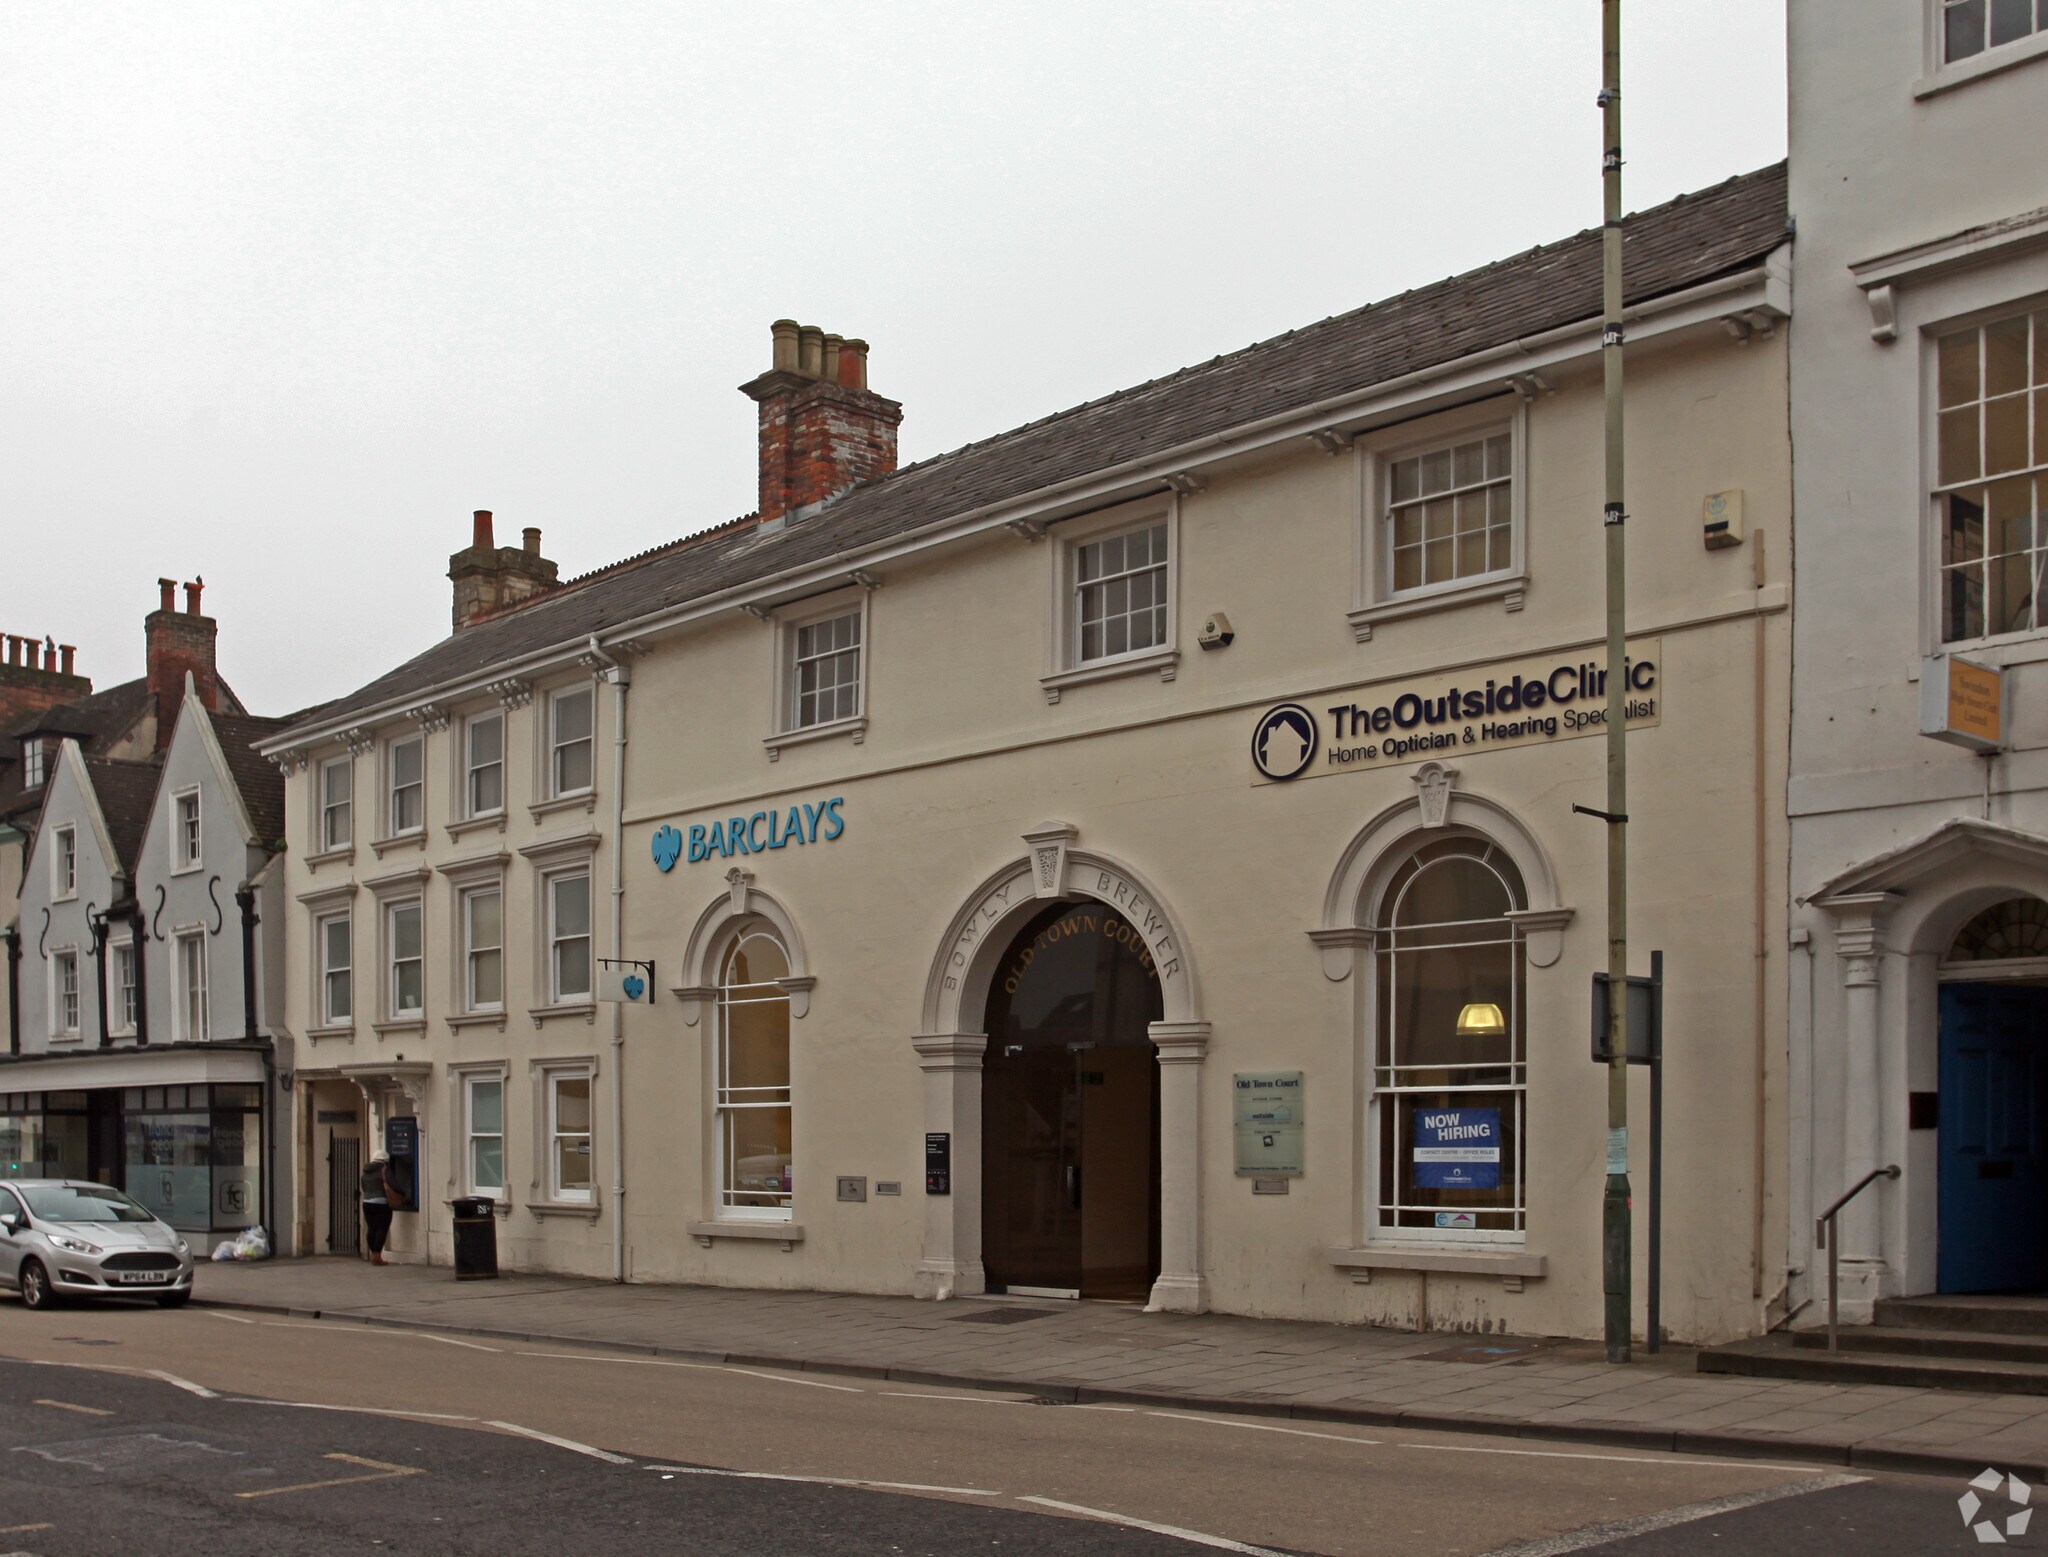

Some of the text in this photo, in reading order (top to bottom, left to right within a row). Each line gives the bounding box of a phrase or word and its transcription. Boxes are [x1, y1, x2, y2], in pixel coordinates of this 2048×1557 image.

[1328, 745, 1377, 764] Home
[1382, 731, 1457, 758] Optician
[1462, 725, 1475, 744] &
[1481, 716, 1557, 741] Hearing
[687, 796, 845, 863] BARCLAYS
[943, 871, 1181, 992] BOWLY BREWER
[1004, 947, 1035, 995] OLD
[1034, 915, 1099, 950] TOWN
[1236, 1079, 1299, 1089] Old Town Court
[1425, 1113, 1460, 1129] NOW
[1437, 1124, 1490, 1141] HIRING
